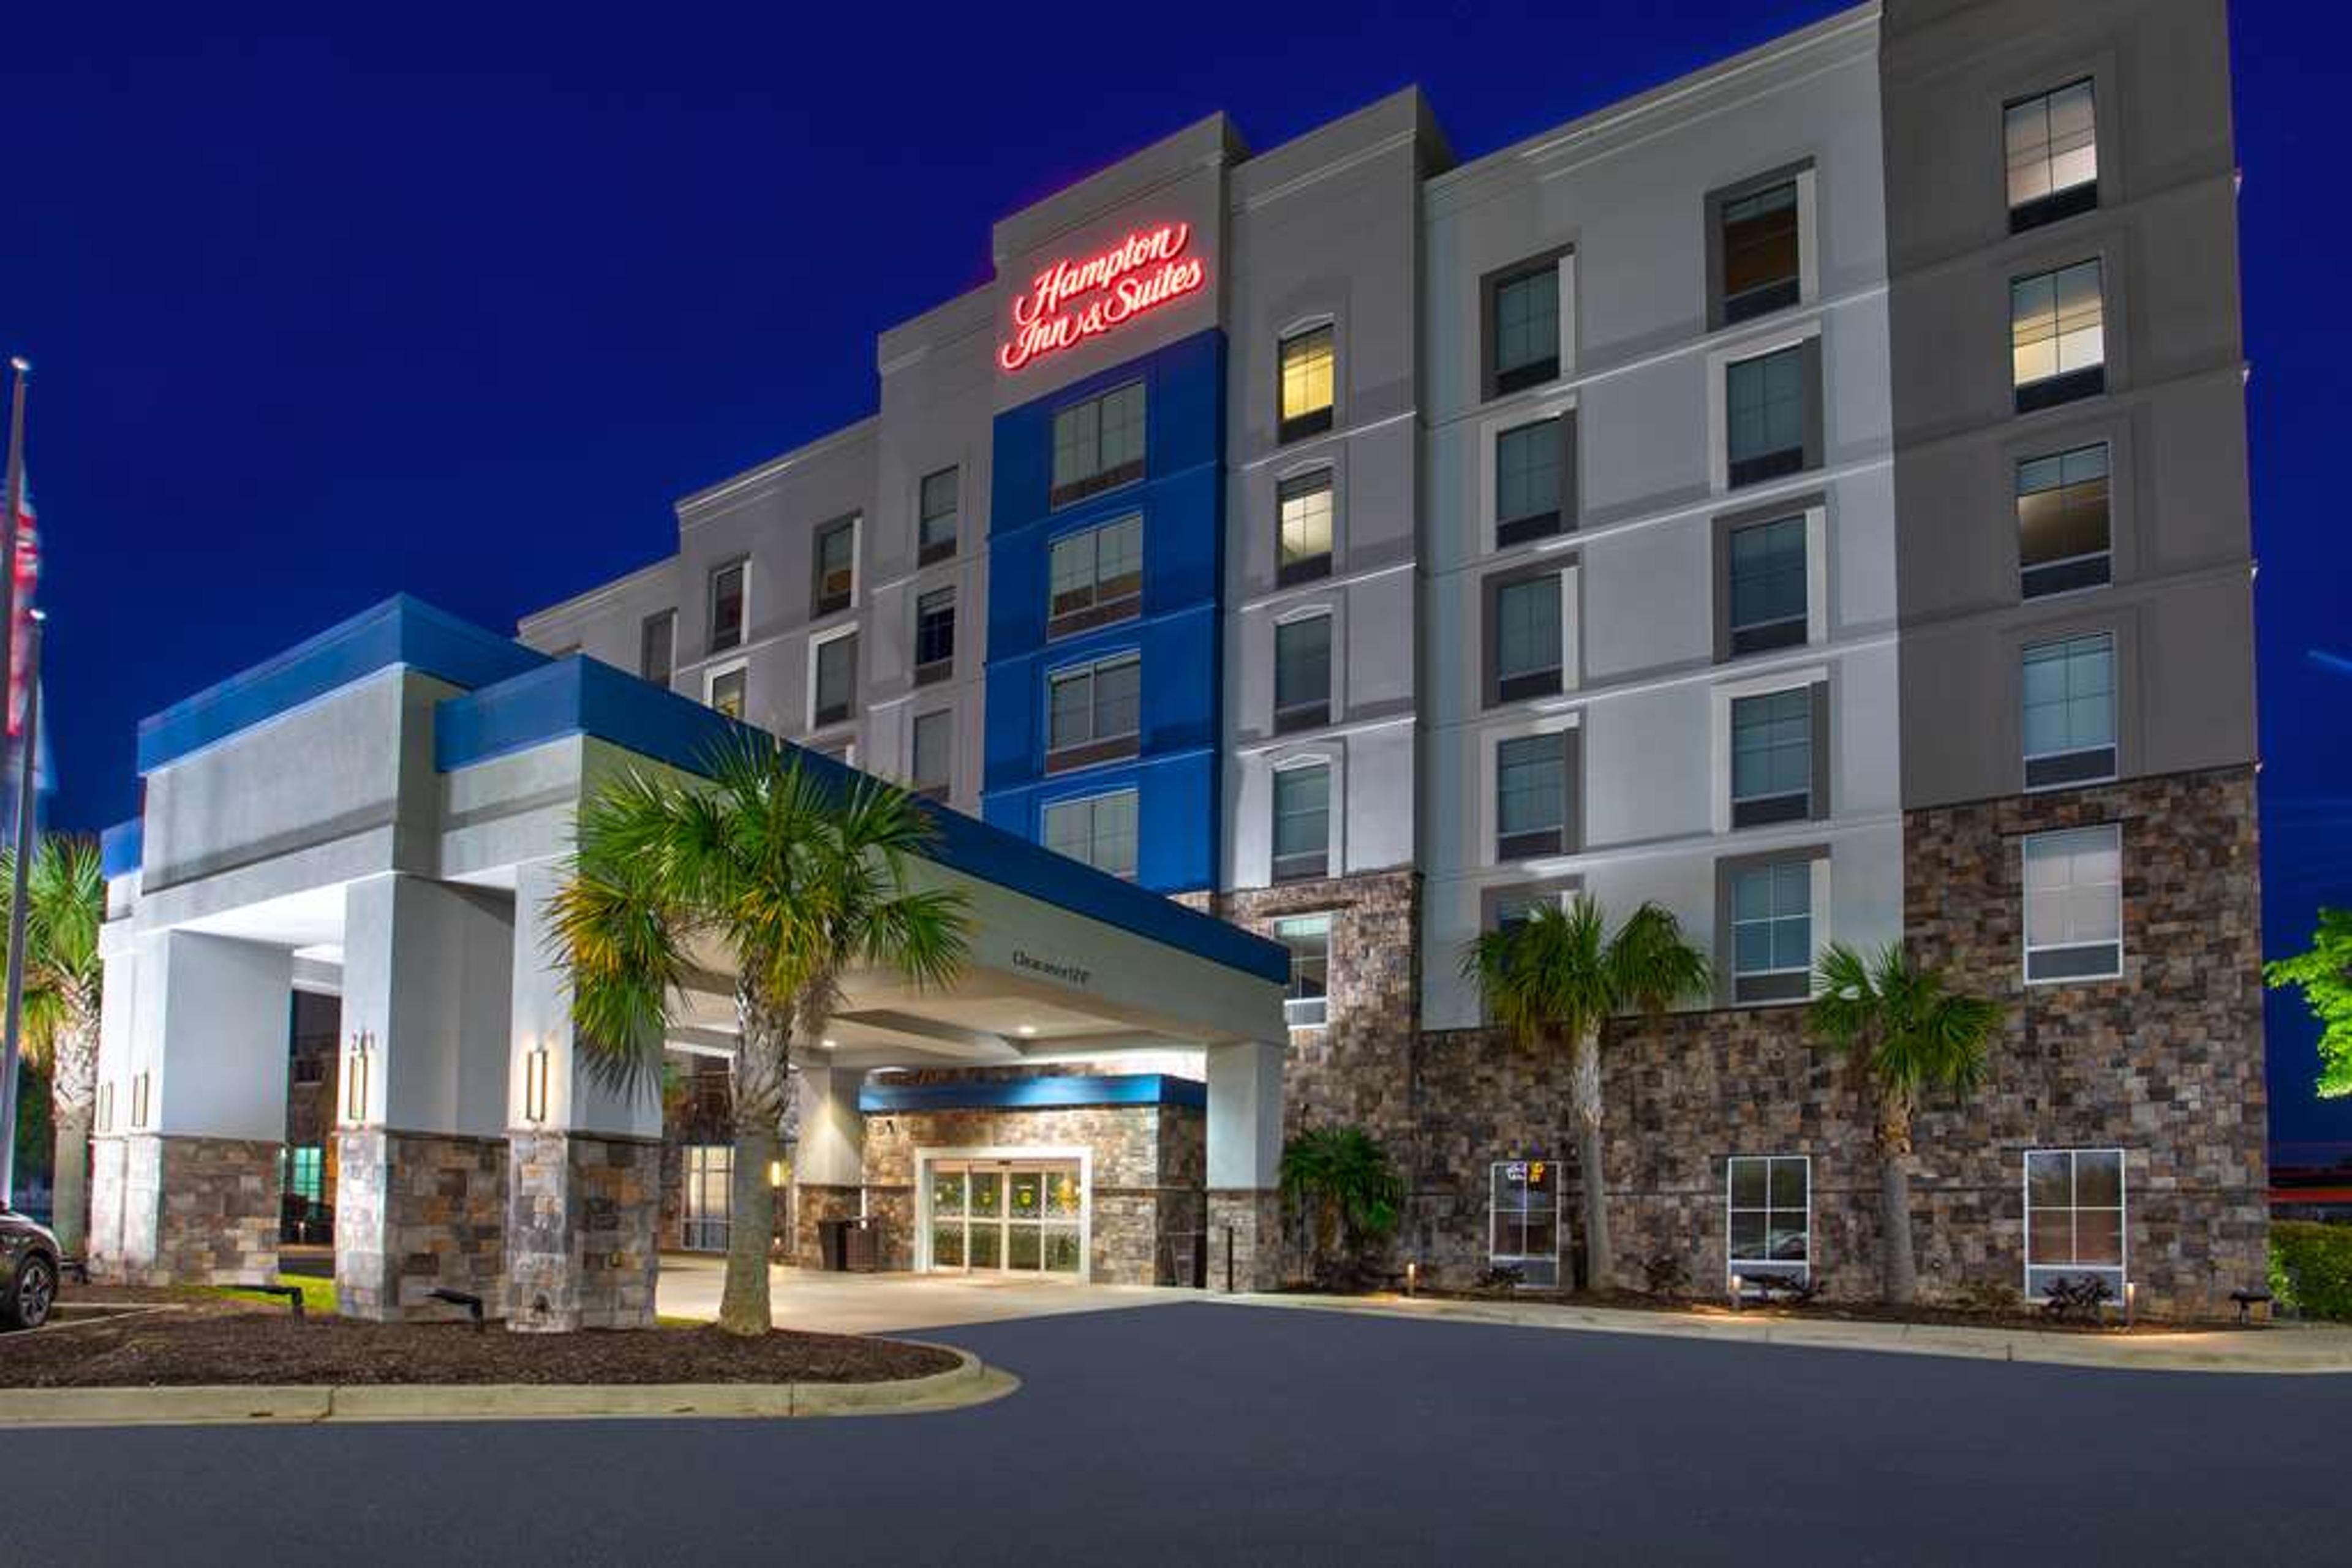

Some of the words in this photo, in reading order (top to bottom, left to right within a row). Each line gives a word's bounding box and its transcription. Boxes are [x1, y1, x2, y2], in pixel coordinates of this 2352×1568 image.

[1001, 314, 1083, 369] Inn
[1082, 303, 1107, 335] &
[1103, 258, 1203, 323] Suites
[1015, 222, 1188, 325] Hampton
